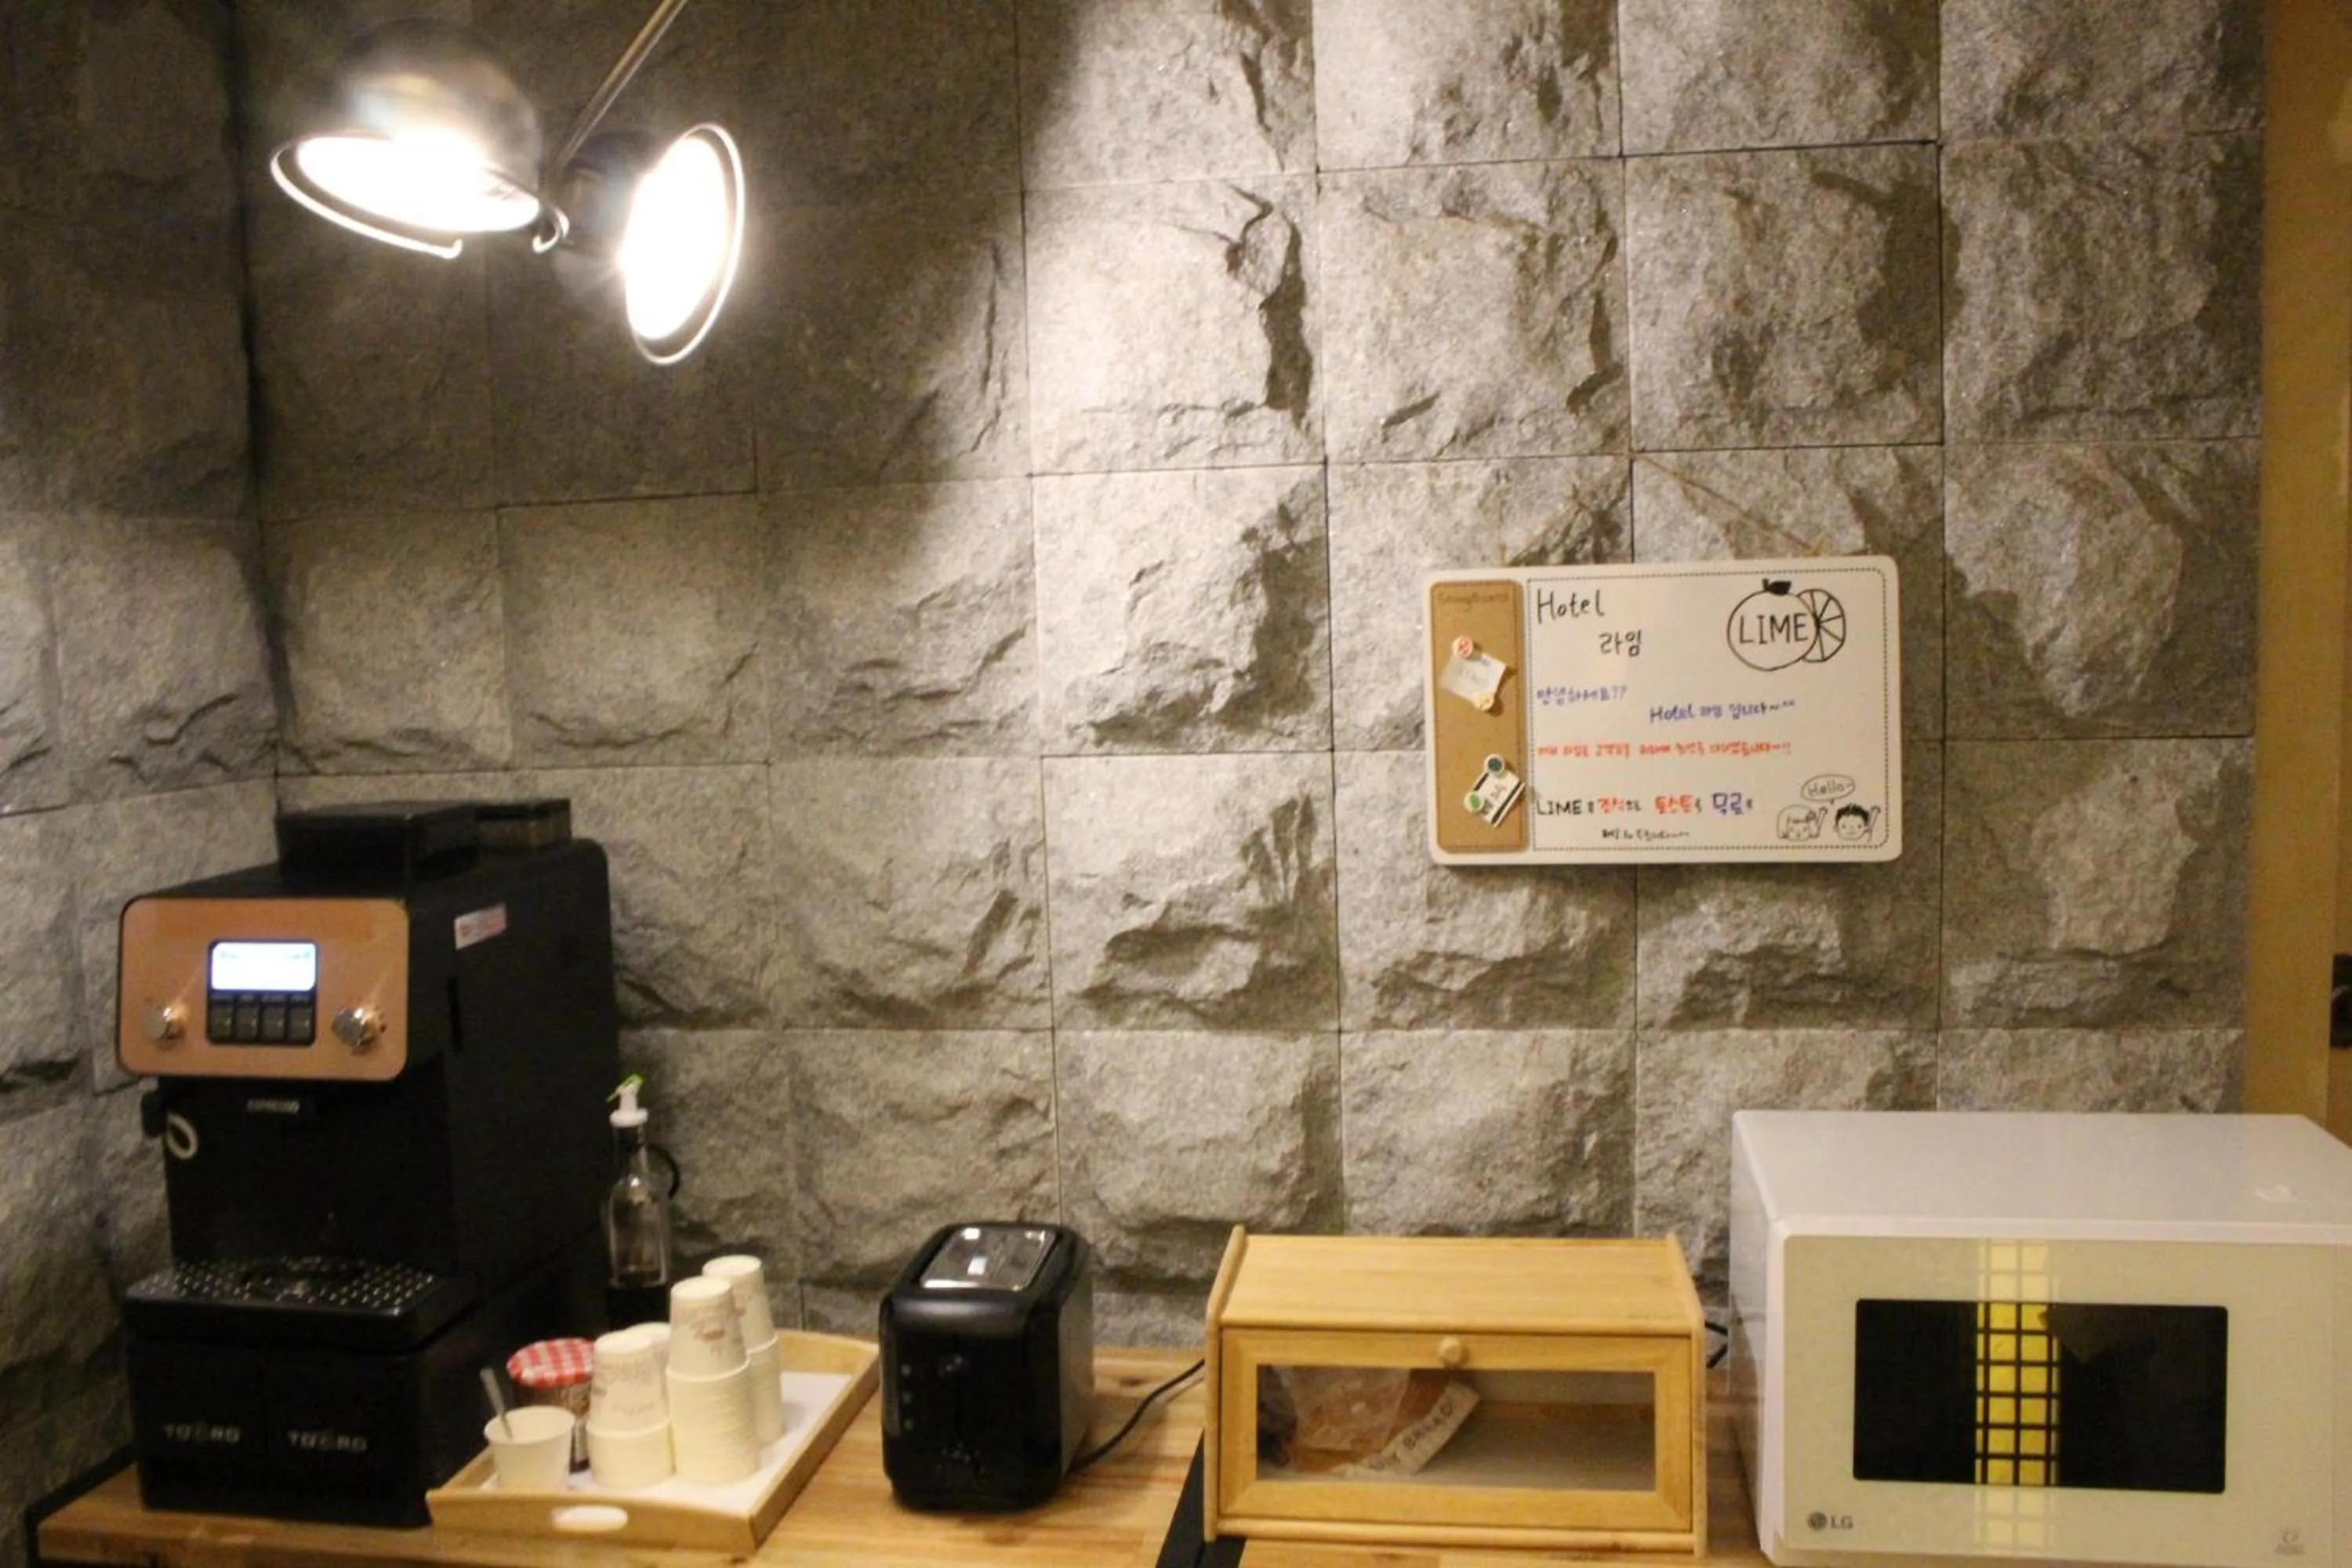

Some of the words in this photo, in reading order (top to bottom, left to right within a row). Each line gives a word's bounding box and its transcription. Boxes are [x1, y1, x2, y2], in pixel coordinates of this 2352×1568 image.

[1537, 588, 1606, 625] Hotel
[1739, 613, 1809, 644] LIME
[1599, 629, 1642, 658] 라임
[1650, 704, 1695, 724] Hotel
[1831, 1514, 1855, 1530] LG
